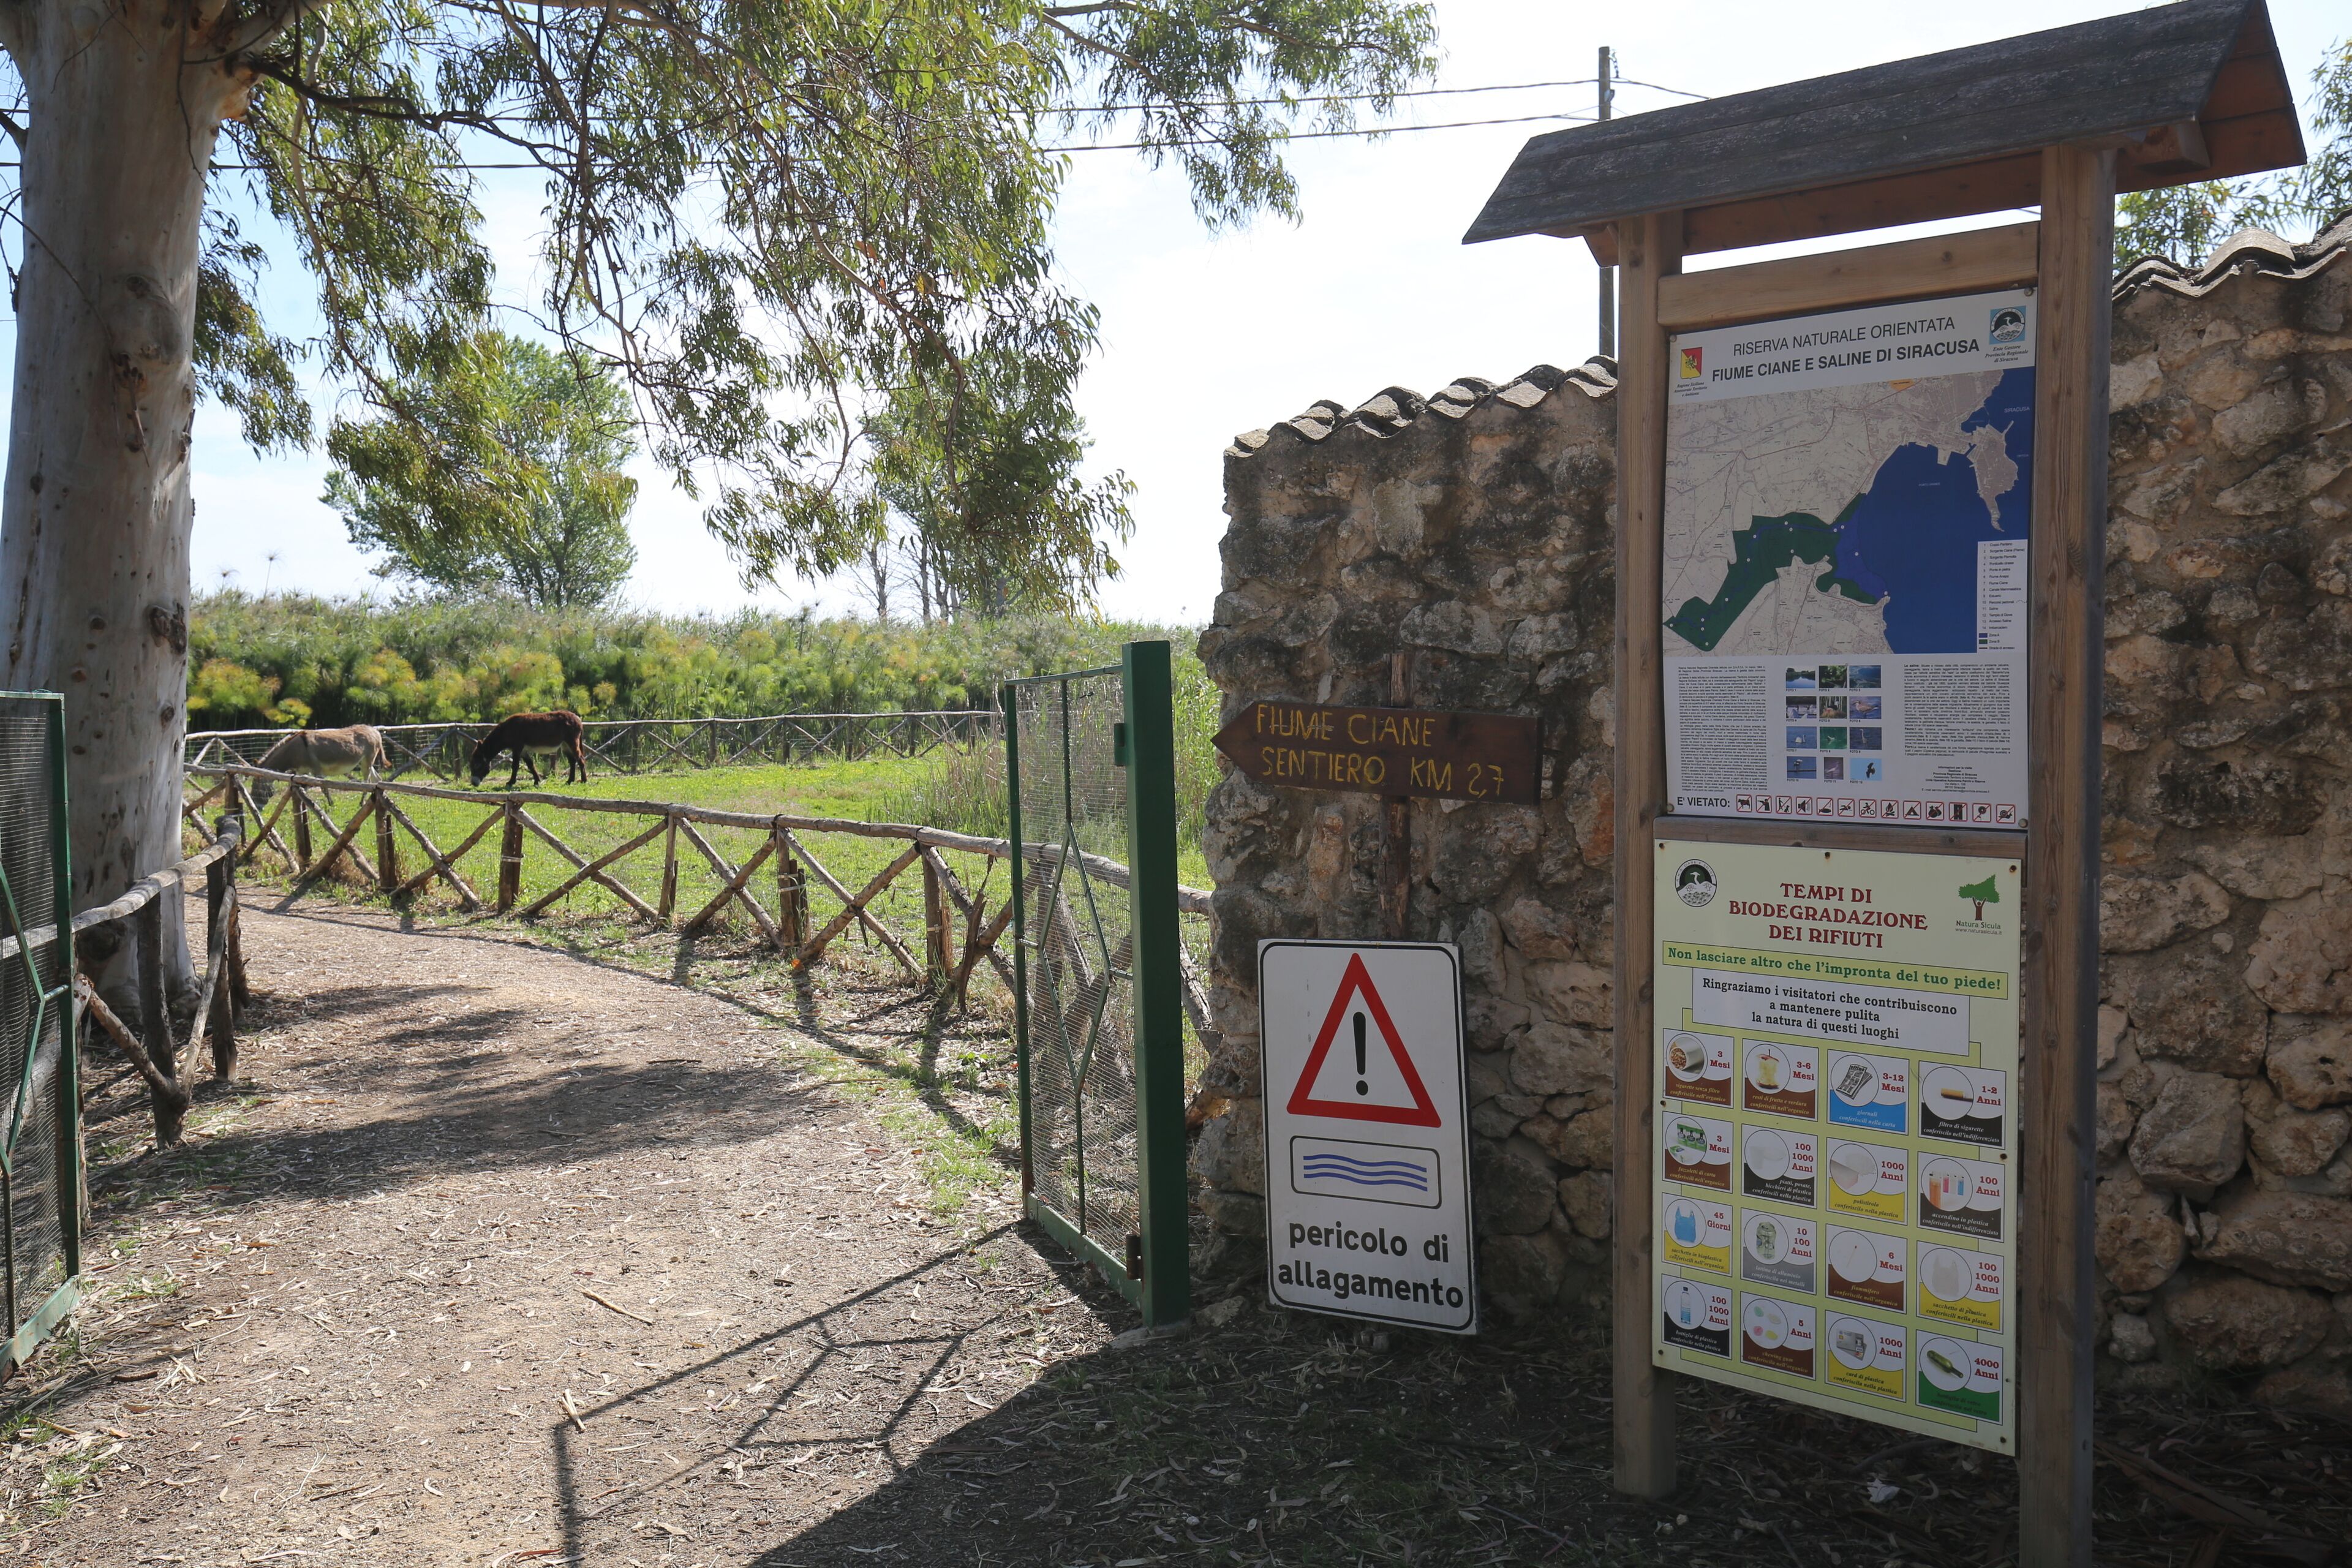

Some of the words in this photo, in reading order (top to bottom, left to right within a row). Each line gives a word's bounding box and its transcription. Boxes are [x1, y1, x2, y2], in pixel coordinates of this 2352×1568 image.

[1733, 337, 1789, 356] RISERVA
[1793, 327, 1866, 349] NATURALE
[1871, 316, 1955, 339] ORIENTATA
[1712, 364, 1754, 382] FIUME
[1757, 358, 1801, 377] CIANE
[1804, 356, 1814, 371] E
[1818, 350, 1872, 370] SALINE
[1876, 347, 1891, 363] DI
[1896, 338, 1980, 360] SIRACUSA
[1256, 704, 1333, 741] FIUME
[1348, 714, 1436, 747] CIANE
[1262, 746, 1385, 785] SENTIERO
[1410, 756, 1452, 791] KM
[1677, 796, 1685, 805] E'
[1687, 797, 1730, 807] VIETATO:
[1780, 883, 1844, 902] TEMPI
[1850, 888, 1872, 903] DI
[1729, 900, 1928, 930] BIODEGRADAZIONE
[1955, 919, 1979, 929] Natura
[1981, 921, 2001, 930] Sicula
[1768, 924, 1802, 941] DEI
[1809, 928, 1883, 949] RIFIUTI
[1668, 948, 1692, 959] Non
[1697, 950, 1746, 964] lasciare
[1751, 956, 1782, 968] altro
[1787, 960, 1811, 971] che
[1816, 962, 1891, 979] l'impronta
[1896, 969, 1918, 982] del
[1924, 973, 1949, 985] tuo
[1954, 976, 2000, 990] piede!
[1703, 978, 1771, 995] Ringraziamo
[1774, 986, 1779, 995] i
[1782, 987, 1835, 1001] visitatori
[1840, 993, 1860, 1004] che
[1864, 997, 1957, 1014] contribuiscono
[1780, 1003, 1841, 1017] mantenere
[1845, 1009, 1880, 1022] pulita
[1752, 1012, 1762, 1022] la
[1766, 1016, 1803, 1027] natura
[1807, 1019, 1817, 1029] di
[1822, 1020, 1857, 1034] questi
[1861, 1024, 1899, 1040] luoghi
[1709, 1059, 1730, 1069] Mesi
[1796, 1061, 1811, 1069] 3-6
[1793, 1071, 1815, 1081] Mesi
[1882, 1072, 1904, 1082] 3-12
[1882, 1083, 1905, 1093] Mesi
[1981, 1085, 1997, 1094] 1-2
[1977, 1096, 2001, 1106] Anni
[1953, 1132, 1999, 1142] nell'indifferenziato
[1709, 1144, 1730, 1154] Mesi
[1795, 1143, 1811, 1152] 100
[1792, 1153, 1814, 1163] 1000
[1792, 1163, 1813, 1173] Anni
[1881, 1160, 1904, 1171] 1000
[1880, 1171, 1904, 1182] Anni
[1980, 1175, 1998, 1185] 100
[1765, 1182, 1786, 1191] bicchieri
[1976, 1186, 2000, 1197] Anni
[1707, 1220, 1732, 1231] Giorni
[1797, 1227, 1807, 1235] 10
[1952, 1224, 1999, 1235] nell'indifferenziato
[1289, 1221, 1408, 1257] pericolo
[1423, 1234, 1449, 1264] di
[1794, 1237, 1810, 1246] 100
[1698, 1253, 1722, 1262] bioplastica
[1791, 1247, 1812, 1257] Anni
[1879, 1261, 1904, 1272] Mesi
[1978, 1262, 1997, 1272] 100
[1975, 1272, 2000, 1283] 1000
[1278, 1261, 1464, 1308] allagamento
[1851, 1284, 1879, 1294] fiammifero
[1975, 1283, 1999, 1295] Anni
[1711, 1295, 1727, 1305] 100
[1864, 1296, 1898, 1306] nell'organico
[1709, 1305, 1729, 1316] 1000
[1709, 1315, 1728, 1326] Anni
[1790, 1328, 1812, 1339] Anni
[1880, 1336, 1902, 1348] 1000
[1879, 1348, 1902, 1359] Anni
[1974, 1357, 1999, 1369] 4000
[1975, 1368, 1999, 1380] Anni
[1877, 1385, 1897, 1394] plastica
